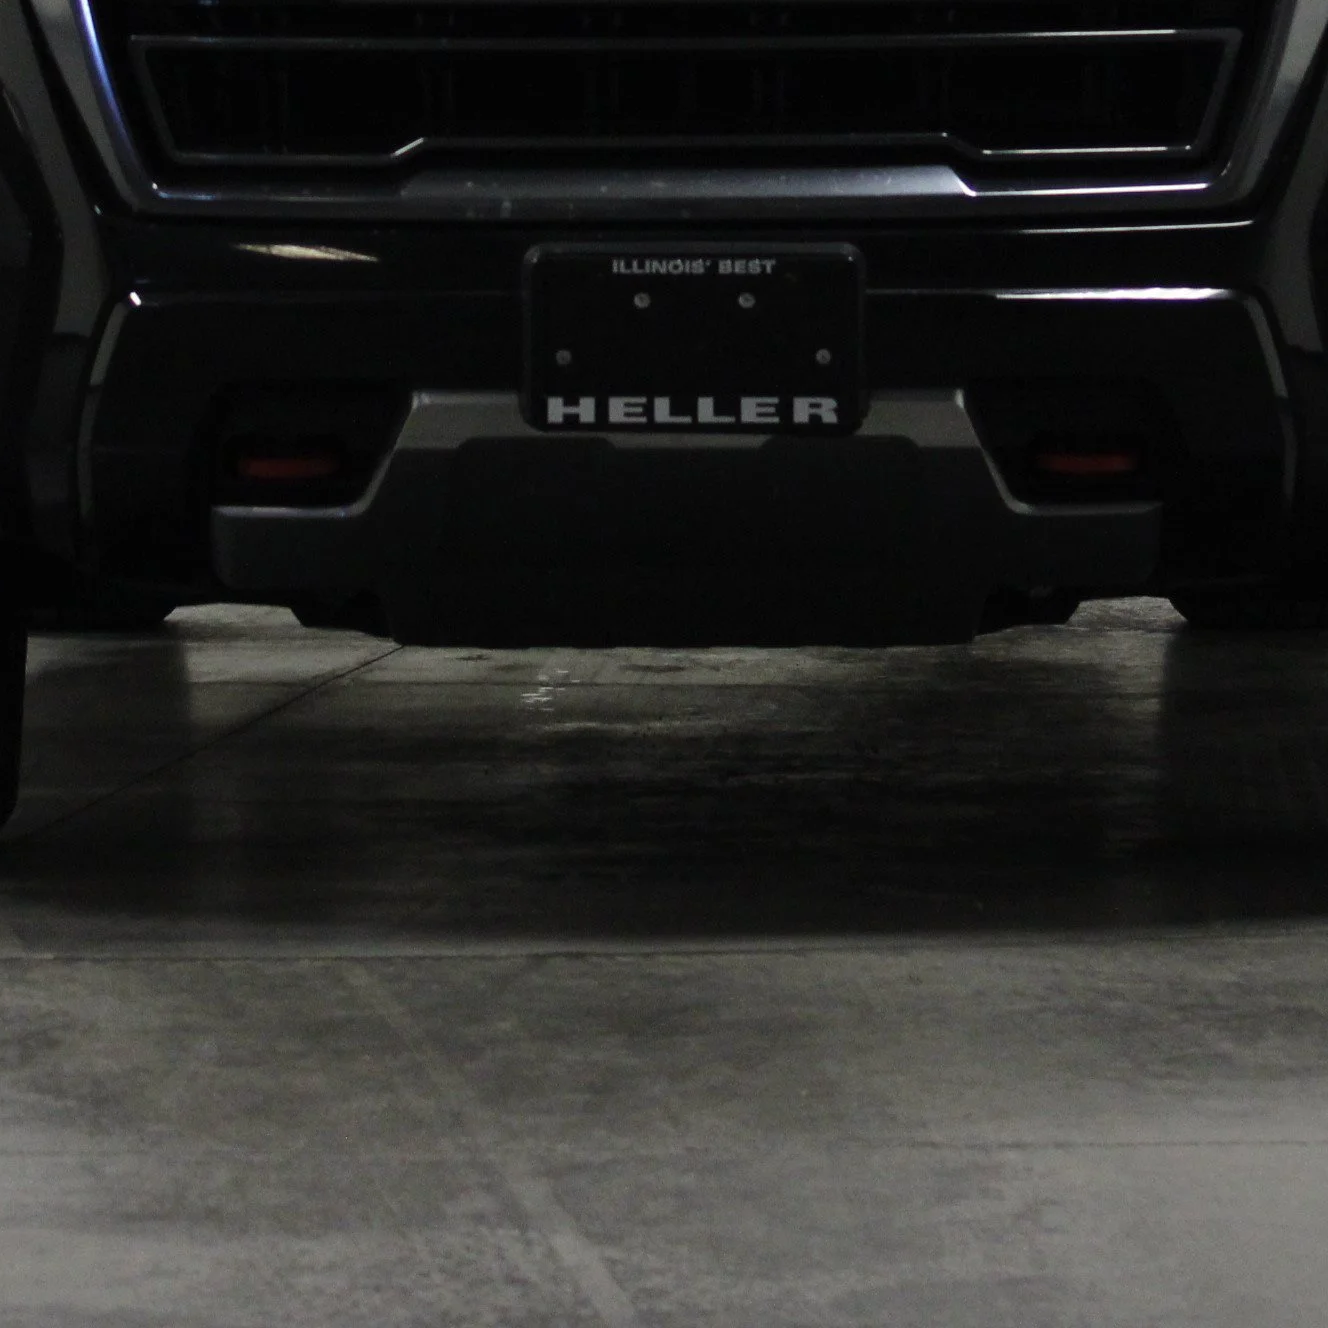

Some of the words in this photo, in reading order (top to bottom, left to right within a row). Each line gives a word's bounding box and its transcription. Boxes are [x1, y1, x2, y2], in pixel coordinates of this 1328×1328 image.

[611, 258, 711, 275] ILLINOIS'
[717, 258, 777, 275] BEST
[546, 396, 839, 424] HELLER
